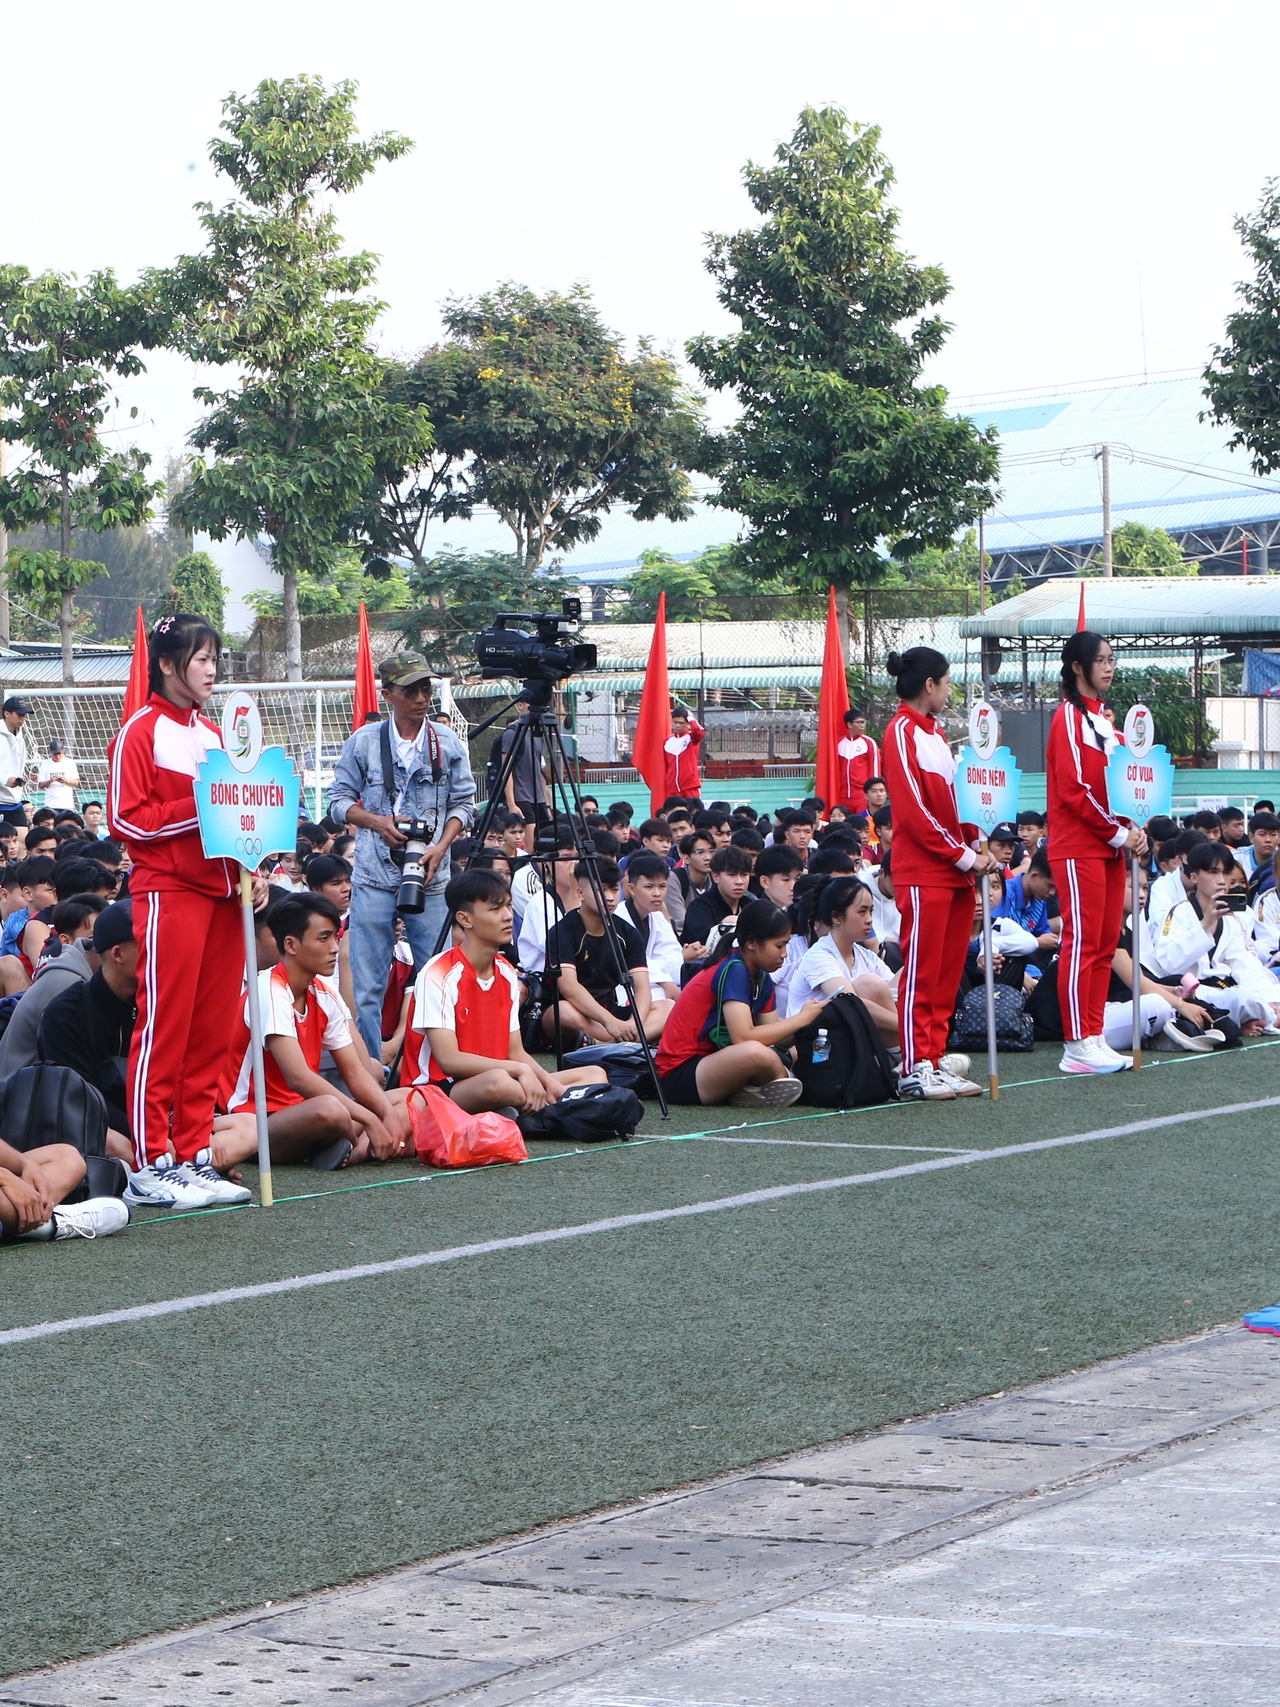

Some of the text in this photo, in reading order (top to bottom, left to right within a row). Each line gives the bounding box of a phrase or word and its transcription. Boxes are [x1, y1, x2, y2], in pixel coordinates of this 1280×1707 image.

[967, 764, 1006, 787] BÓNG NÉM
[1127, 762, 1154, 782] CỜ VUA
[210, 778, 239, 806] BÓNG
[981, 792, 992, 805] 909
[1134, 787, 1146, 800] 910
[240, 814, 255, 831] 908
